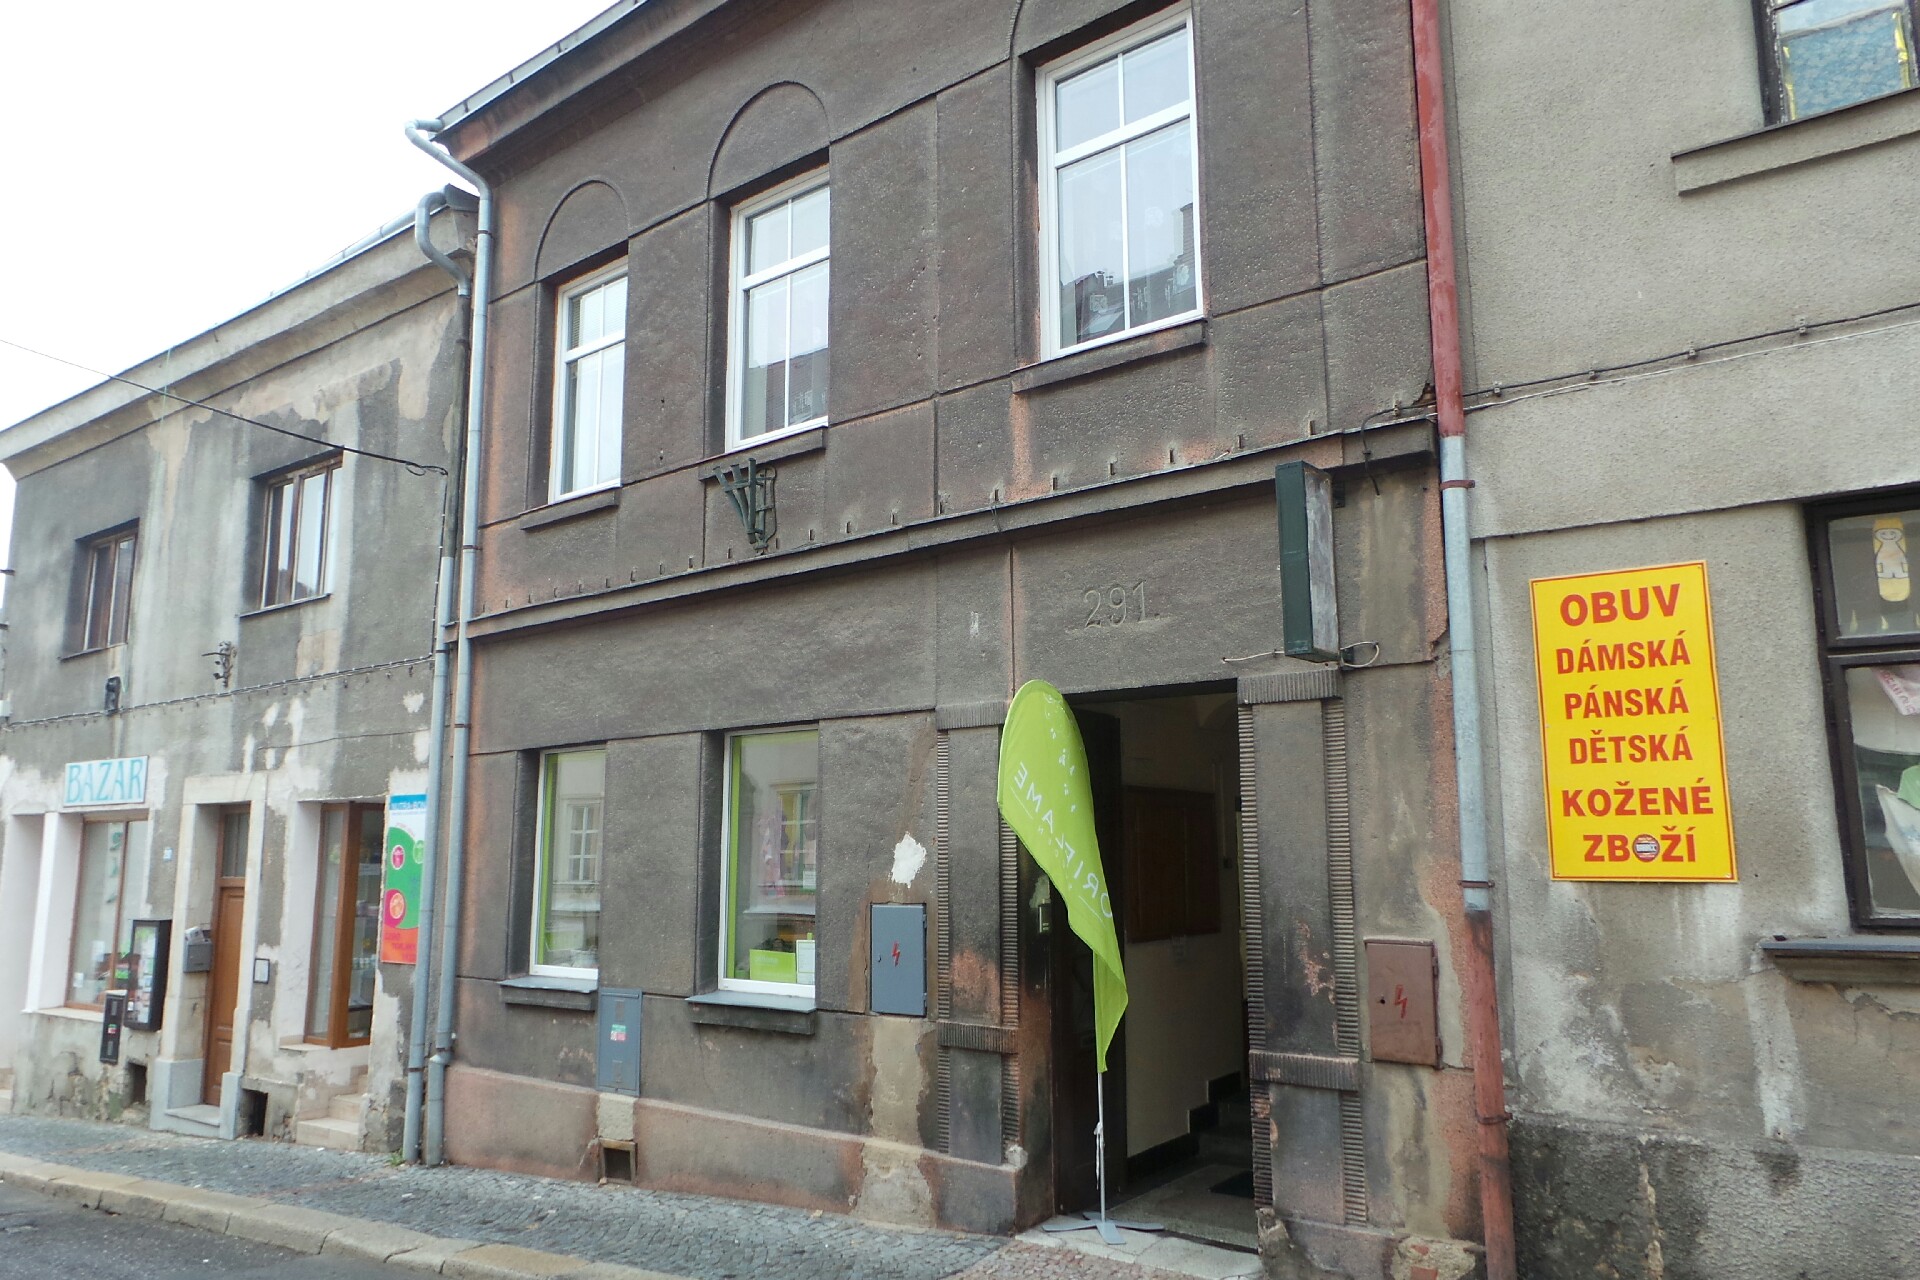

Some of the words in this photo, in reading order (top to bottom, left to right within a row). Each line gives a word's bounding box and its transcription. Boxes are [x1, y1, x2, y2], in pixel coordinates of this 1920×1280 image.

[1084, 578, 1147, 629] 291
[1559, 583, 1681, 627] OBUV
[1556, 630, 1691, 675] DÁMSKÁ
[1564, 678, 1690, 720] PÁNSKÁ
[1569, 725, 1693, 765] DĚTSKÁ
[66, 758, 144, 803] BAZAR
[1561, 777, 1714, 818] KOŽENÉ
